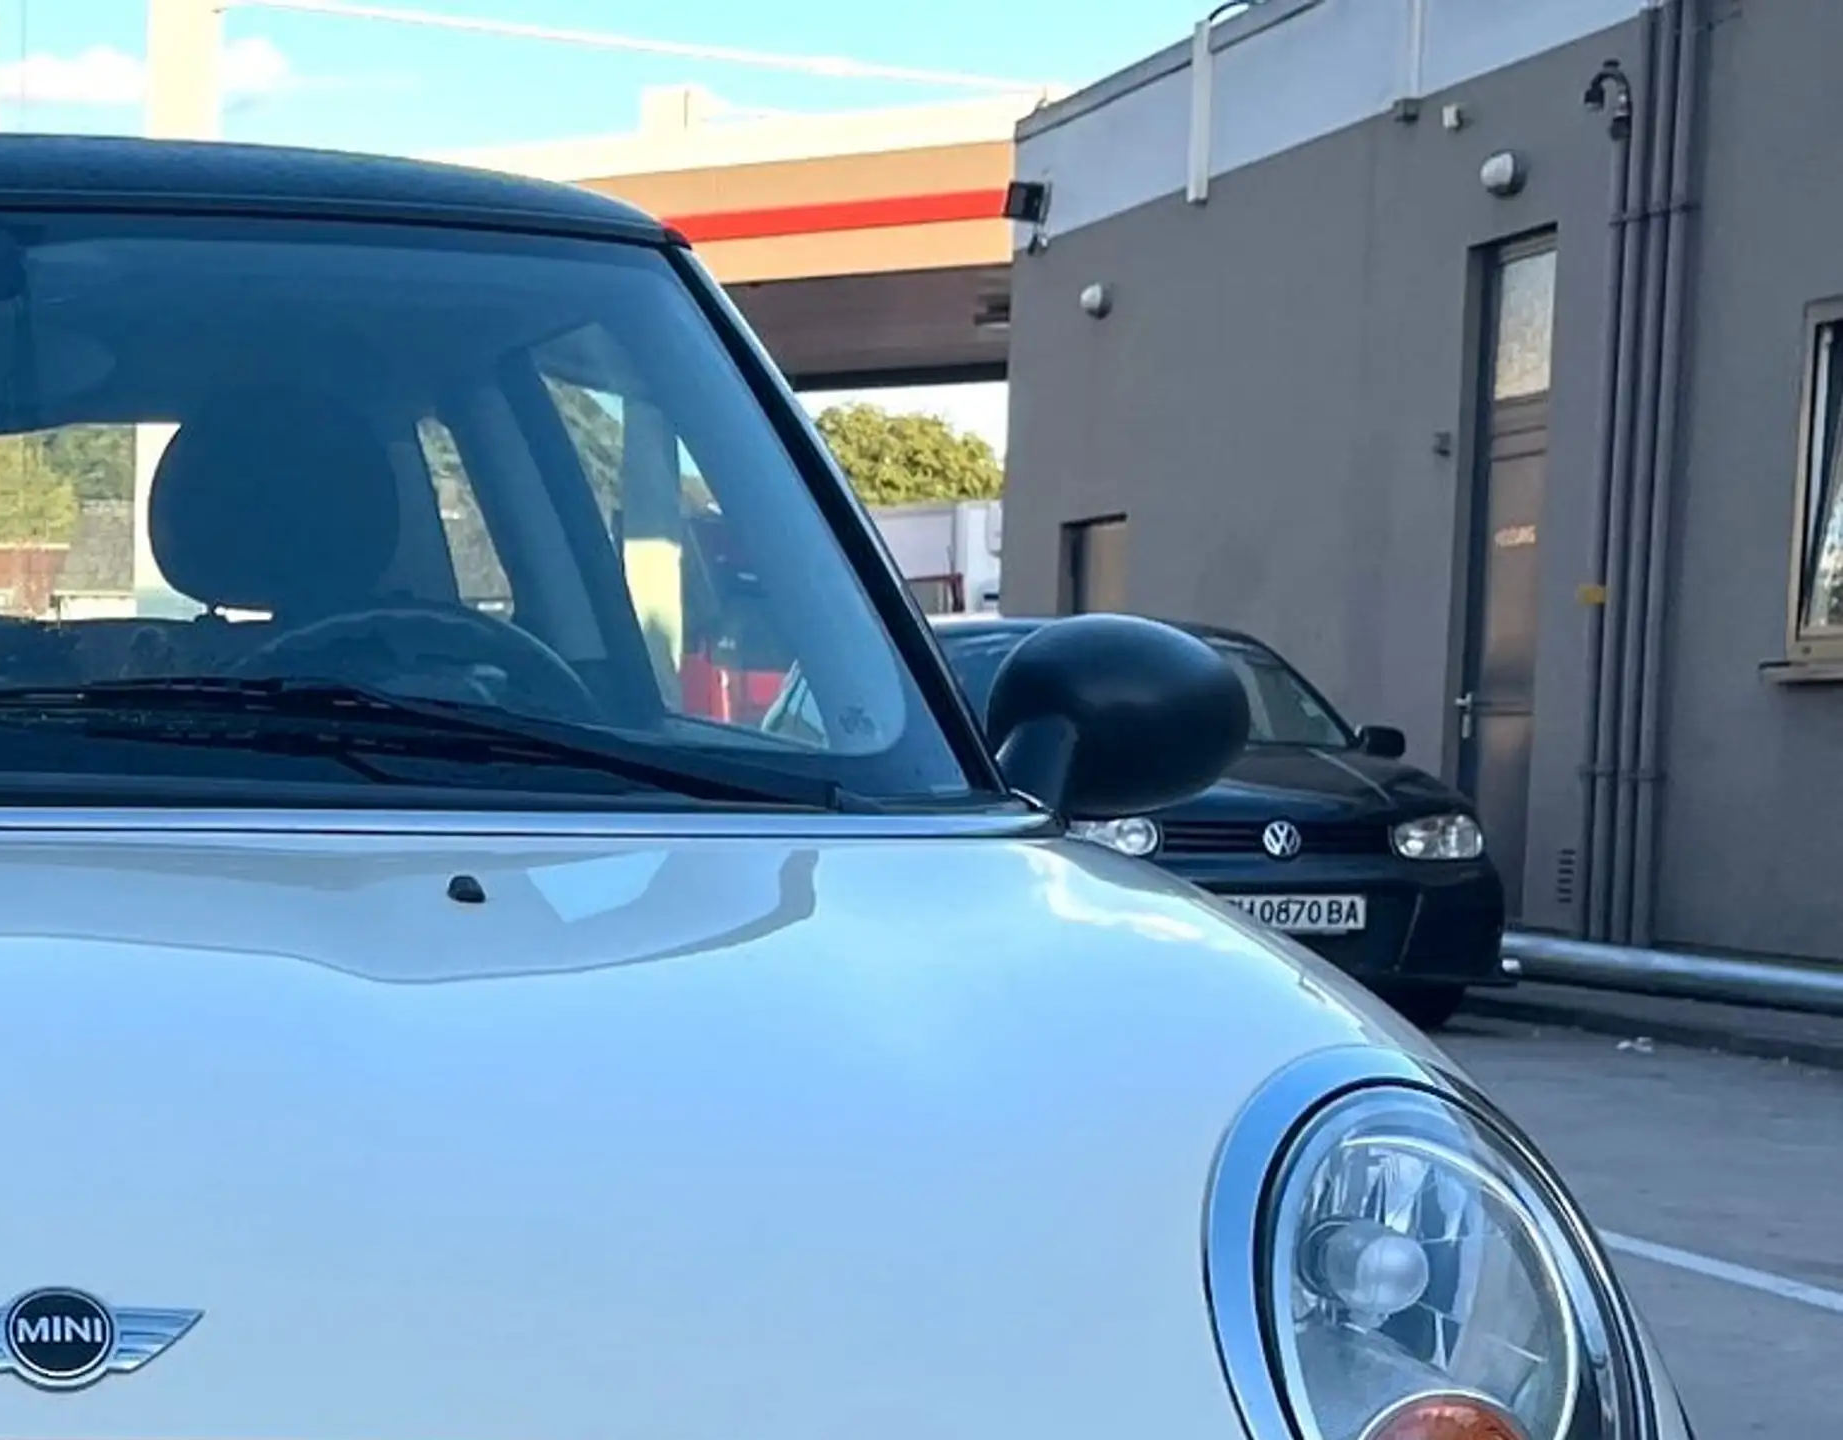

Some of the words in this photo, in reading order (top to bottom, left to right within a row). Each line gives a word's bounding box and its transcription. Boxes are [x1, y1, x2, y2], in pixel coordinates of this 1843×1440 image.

[1260, 899, 1322, 924] 0870
[1327, 900, 1359, 924] BA
[16, 1315, 104, 1344] MINI
